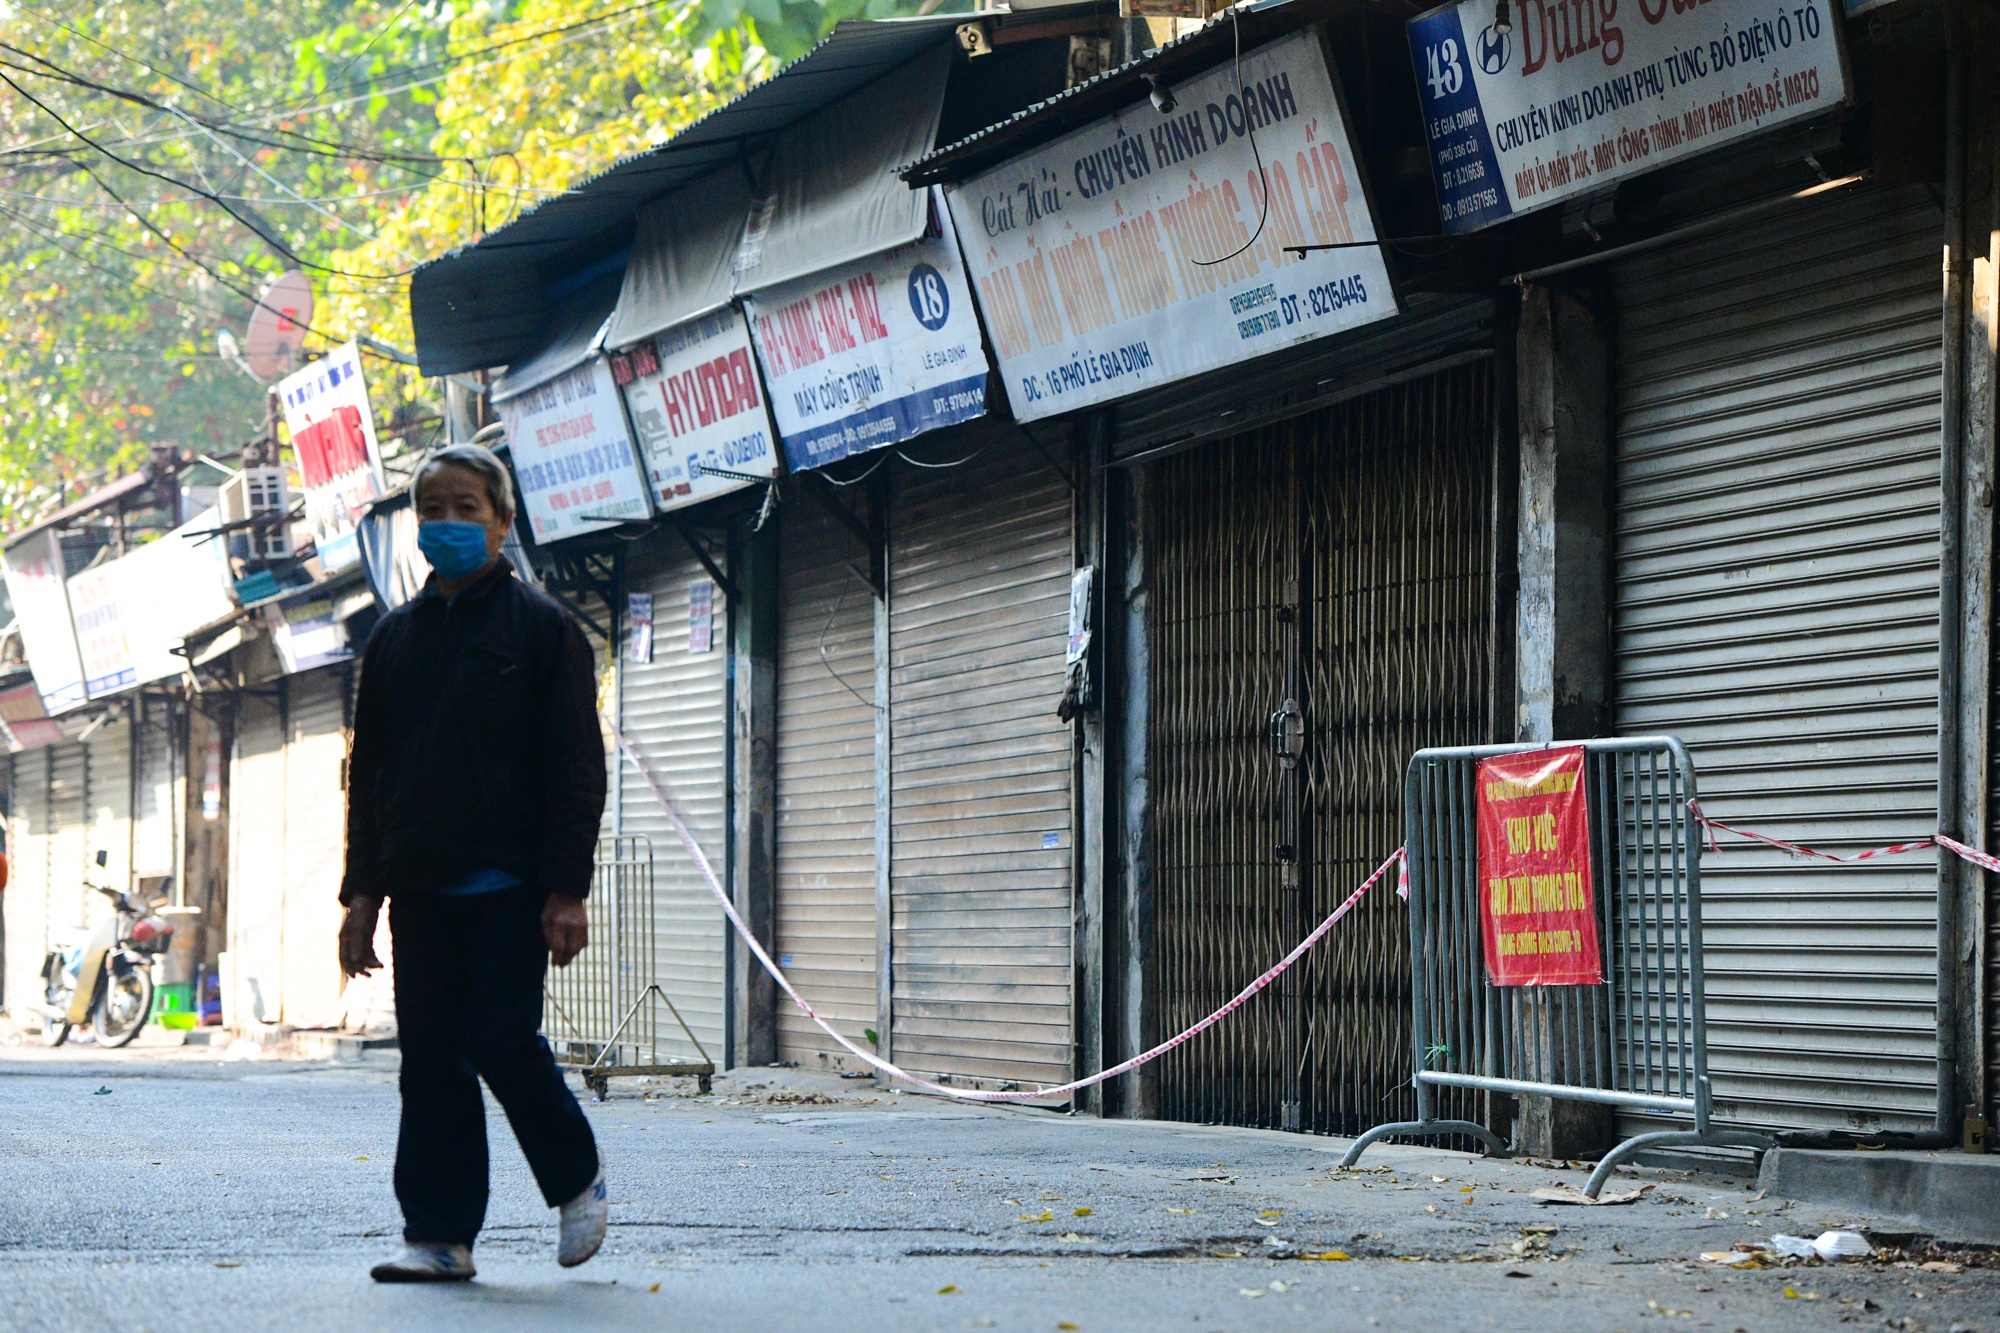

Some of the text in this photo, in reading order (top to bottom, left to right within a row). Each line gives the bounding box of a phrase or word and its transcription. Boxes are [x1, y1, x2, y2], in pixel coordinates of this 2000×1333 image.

[1426, 38, 1464, 100] 43
[1496, 104, 1550, 152] CHUYÊN
[1550, 94, 1583, 133] KINH
[1582, 74, 1636, 121] DOANH
[1634, 61, 1665, 101] PHỤ
[1665, 46, 1708, 87] TÙNG
[1709, 22, 1736, 72] ĐỒ
[1738, 18, 1776, 64] ĐIỆN
[1778, 8, 1792, 48] Ô
[1430, 107, 1479, 139] LÊ GIA ĐỊNH
[1453, 143, 1466, 159] 336
[1515, 163, 1536, 199] MÁY
[1617, 127, 1649, 164] CÔNG
[1708, 91, 1736, 133] PHÁT
[1784, 66, 1820, 106] MAZƠ
[982, 190, 1018, 237] Cát
[1074, 128, 1151, 199] CHUYÊN
[1150, 109, 1208, 169] KINH
[1206, 71, 1298, 147] DOANH
[1442, 172, 1454, 190] ĐT
[979, 245, 1032, 361] DẦU
[1098, 200, 1179, 321] THÔNG
[1296, 117, 1355, 254] CẤP
[914, 273, 944, 322] 18
[1279, 294, 1302, 325] ĐT
[1308, 274, 1368, 317] 8215445
[922, 343, 968, 370] LÊ GIA ĐỊNH
[1022, 375, 1042, 402] ĐC
[1046, 370, 1062, 395] 16
[1059, 351, 1086, 391] PHỐ
[1084, 349, 1102, 384] LÊ
[1100, 351, 1125, 380] GIA
[1120, 341, 1154, 379] ĐỊNH
[659, 346, 760, 438] HYUNDAI
[794, 363, 884, 418] MÁY CÔNG TRÌNH
[1507, 813, 1558, 860] KHU VỰC
[1489, 859, 1585, 925] TẠM THỜI PHONG TỎA
